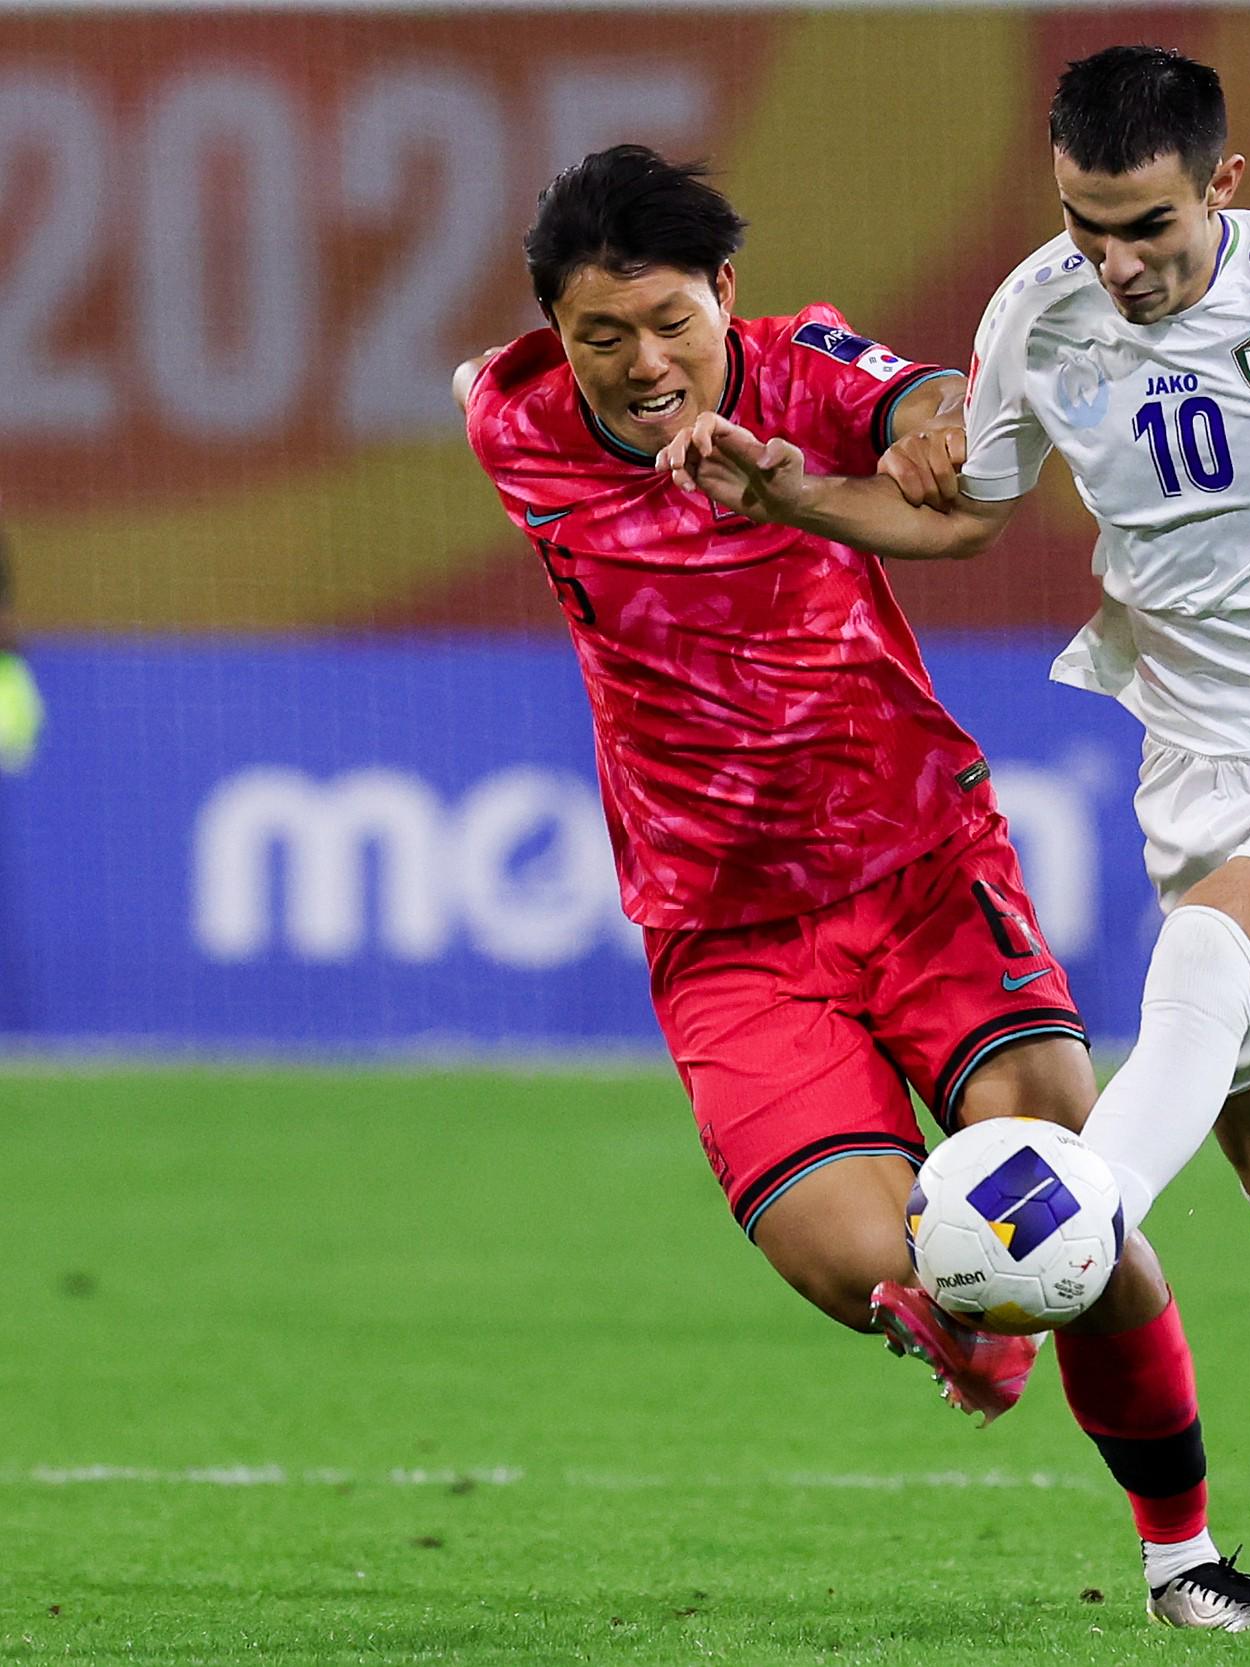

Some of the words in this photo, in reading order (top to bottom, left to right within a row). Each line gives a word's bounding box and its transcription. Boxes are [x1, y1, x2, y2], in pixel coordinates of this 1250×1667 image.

[1145, 373, 1199, 396] JAKO
[1132, 396, 1235, 498] 10
[936, 1270, 986, 1289] molten
